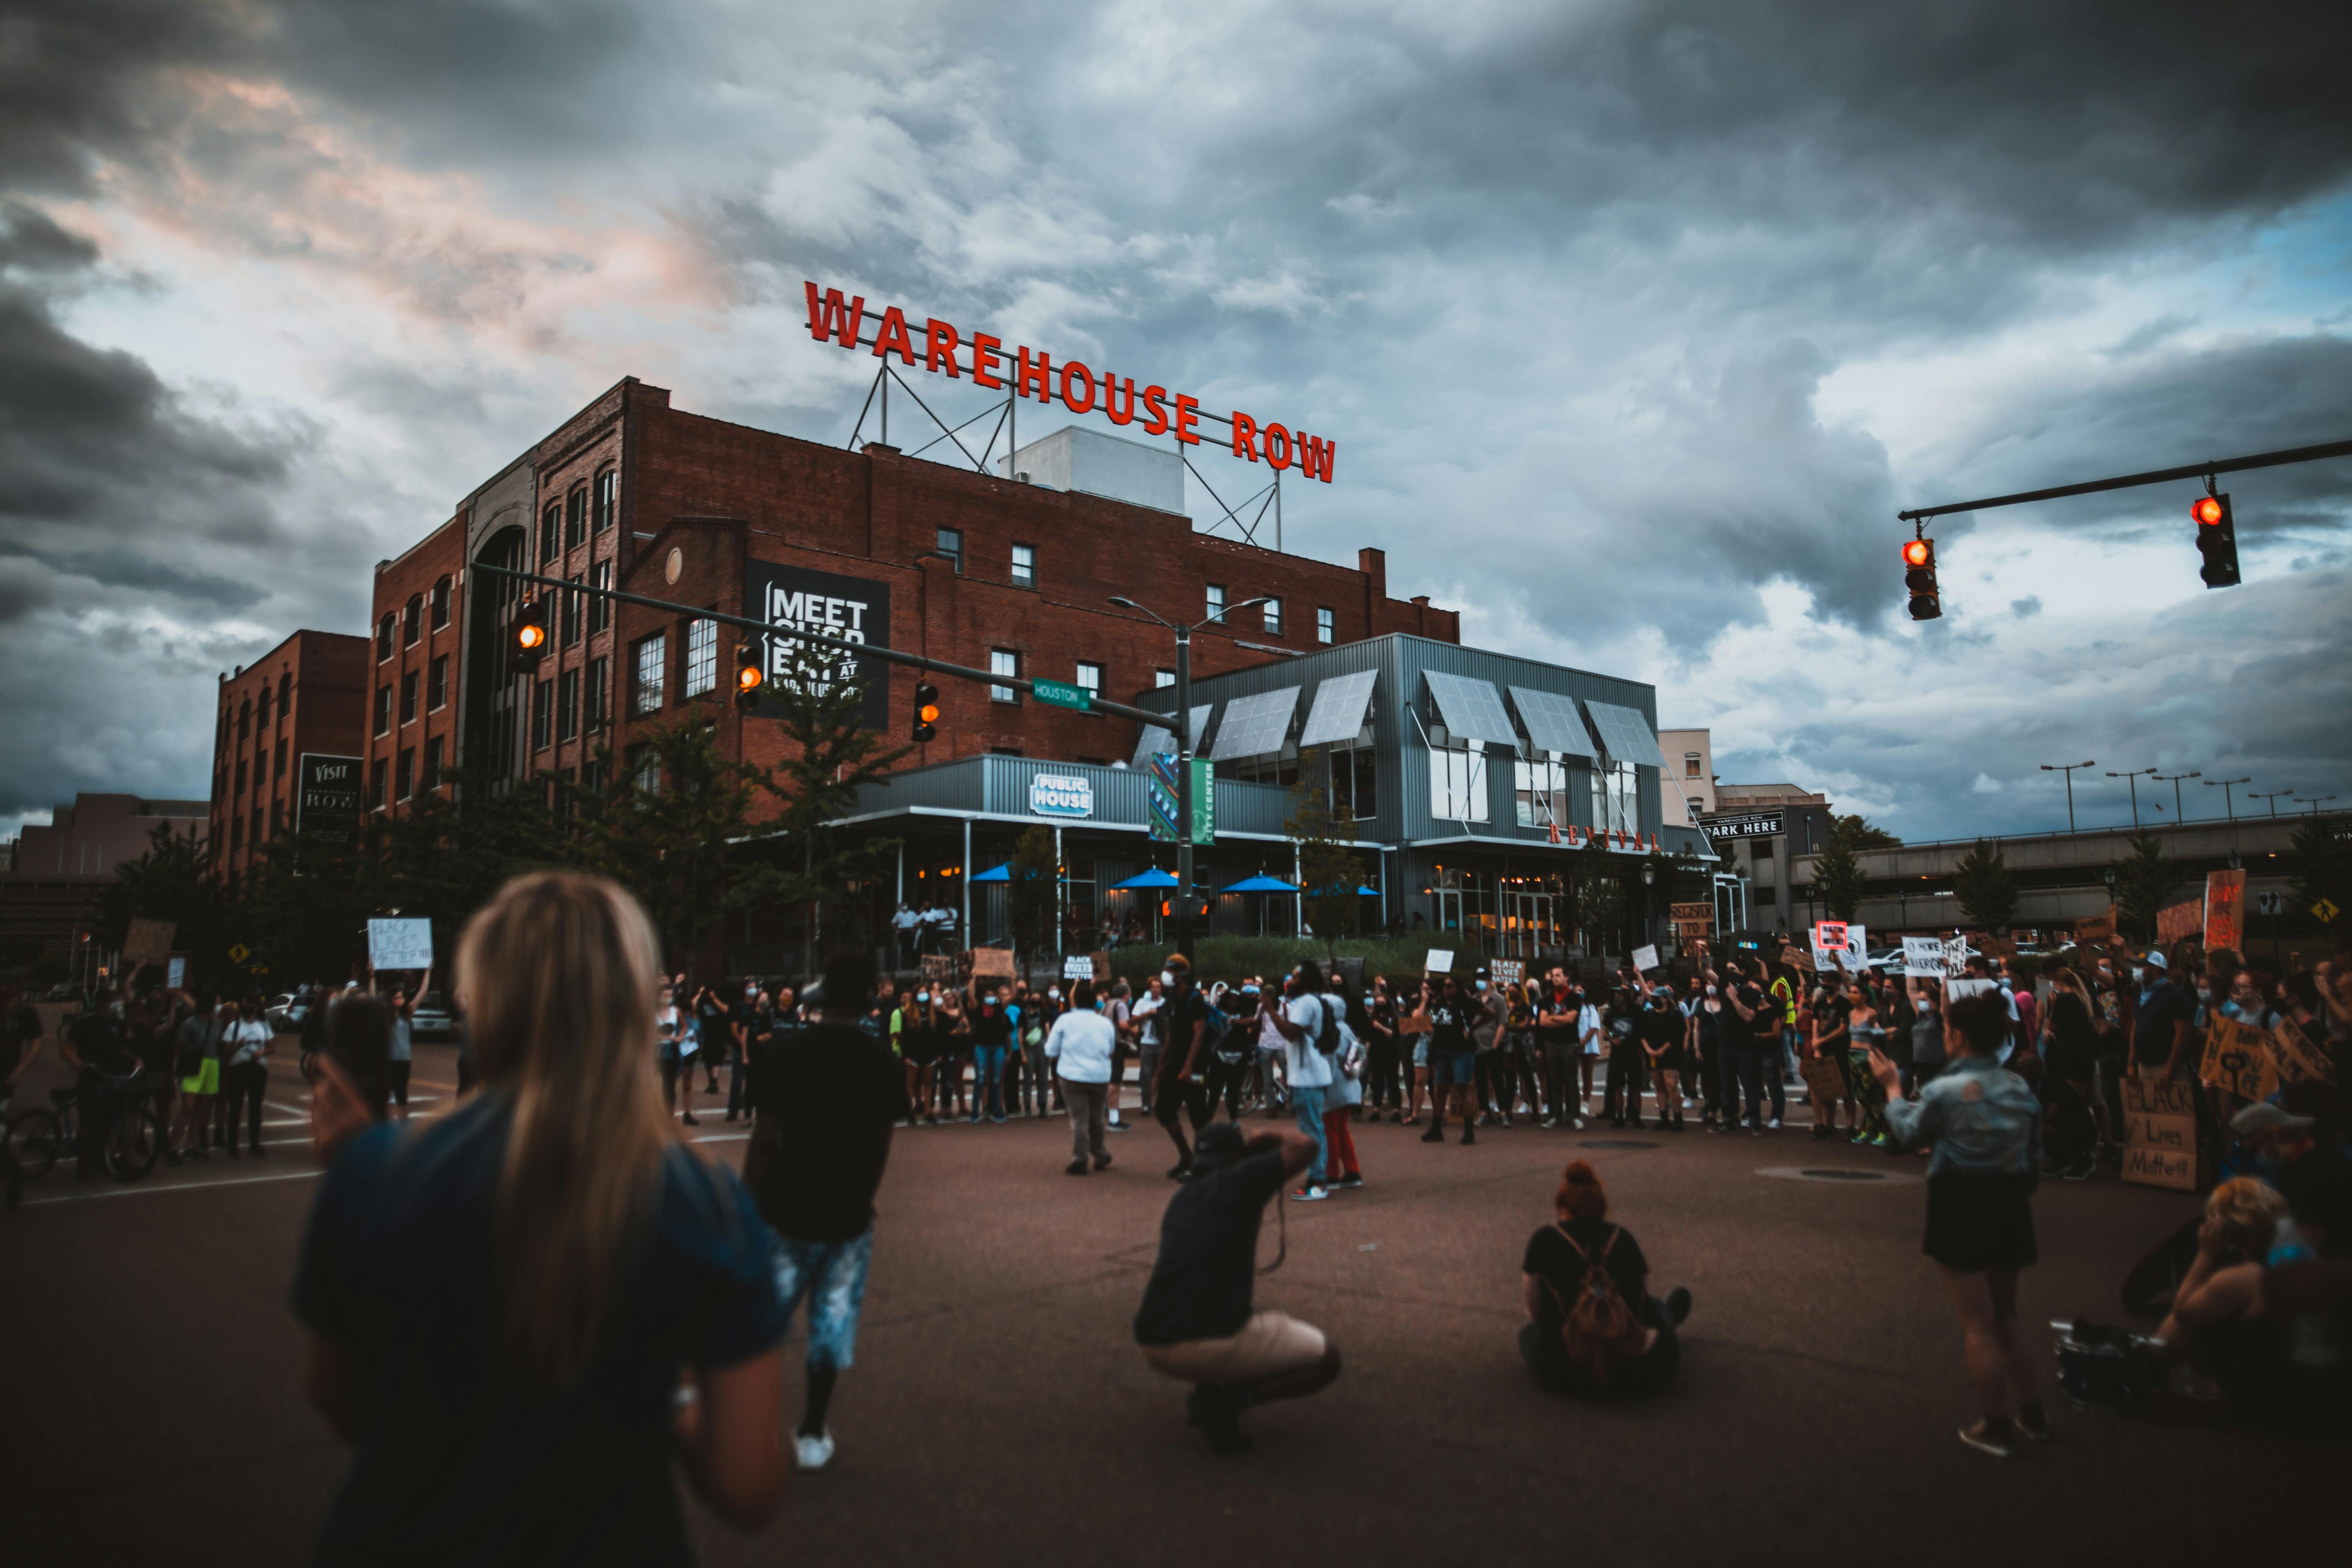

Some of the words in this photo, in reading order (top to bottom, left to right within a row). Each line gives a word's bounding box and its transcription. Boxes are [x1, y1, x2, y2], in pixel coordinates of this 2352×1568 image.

[804, 281, 1200, 445] WAREHOUSE
[1232, 411, 1335, 483] ROW
[773, 588, 867, 630] MEET
[840, 664, 857, 677] AT
[1034, 684, 1078, 702] HOUSTON
[1040, 777, 1085, 792] PUBLIC
[306, 794, 356, 808] ROW
[1035, 790, 1090, 809] HOUSE
[1744, 821, 1777, 833] HERE
[1548, 823, 1662, 851] REVIVAL
[1684, 922, 1699, 934] TO
[1491, 959, 1522, 969] BLACK
[1492, 967, 1519, 976] LIVES
[2127, 1081, 2194, 1114] BLACK
[2146, 1119, 2183, 1145] Lives
